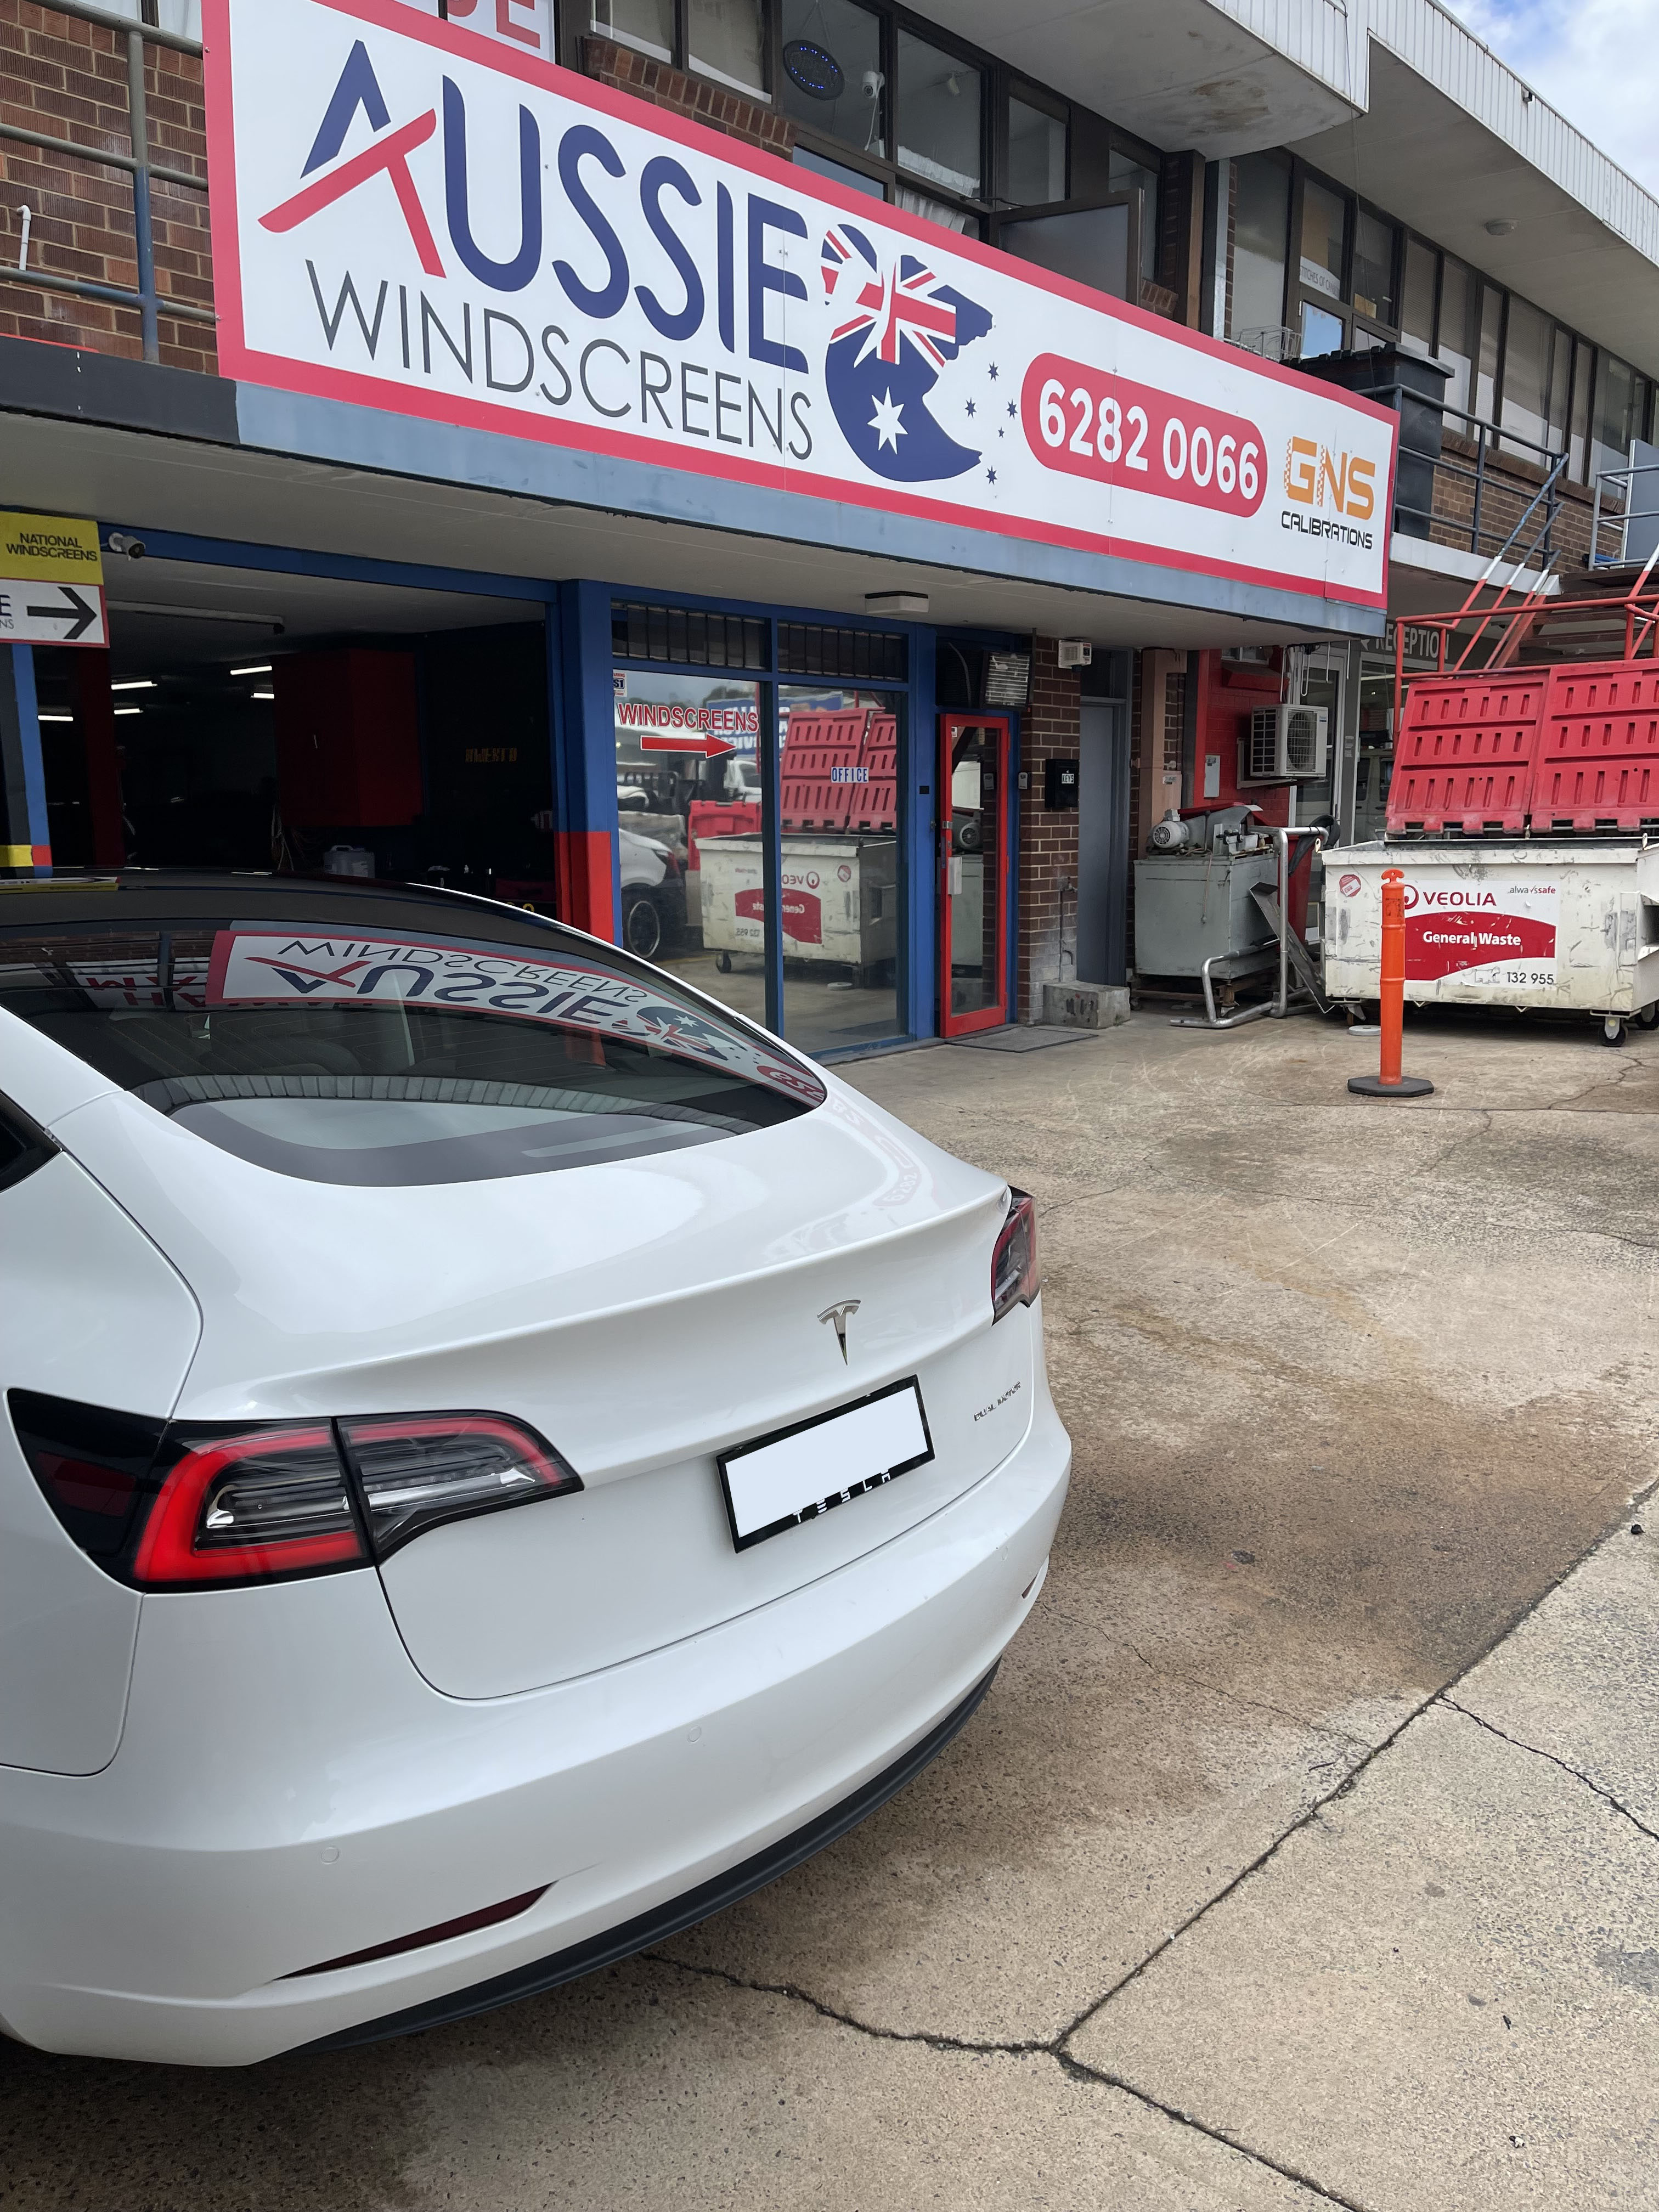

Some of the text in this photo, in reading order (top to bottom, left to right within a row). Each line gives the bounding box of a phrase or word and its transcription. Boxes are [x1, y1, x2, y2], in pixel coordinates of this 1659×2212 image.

[257, 40, 809, 374] AUSSIE
[306, 259, 812, 459] WINDSCREENS
[1040, 379, 1260, 499] 6282 0066
[1284, 436, 1375, 520] GNS
[20, 533, 82, 548] NATIONAL
[1282, 510, 1373, 550] CALIBRATIONS
[5, 543, 98, 561] WINDSCREENS
[618, 703, 759, 732] WINDSCREENS
[832, 768, 867, 782] OFFICE
[1062, 774, 1074, 783] KEYS
[1423, 891, 1497, 906] VEOLIA
[1423, 931, 1521, 945] General Waste
[1507, 972, 1554, 985] 132 955
[974, 1381, 1021, 1421] DUAL MOTOR
[792, 1469, 891, 1523] TESLA
